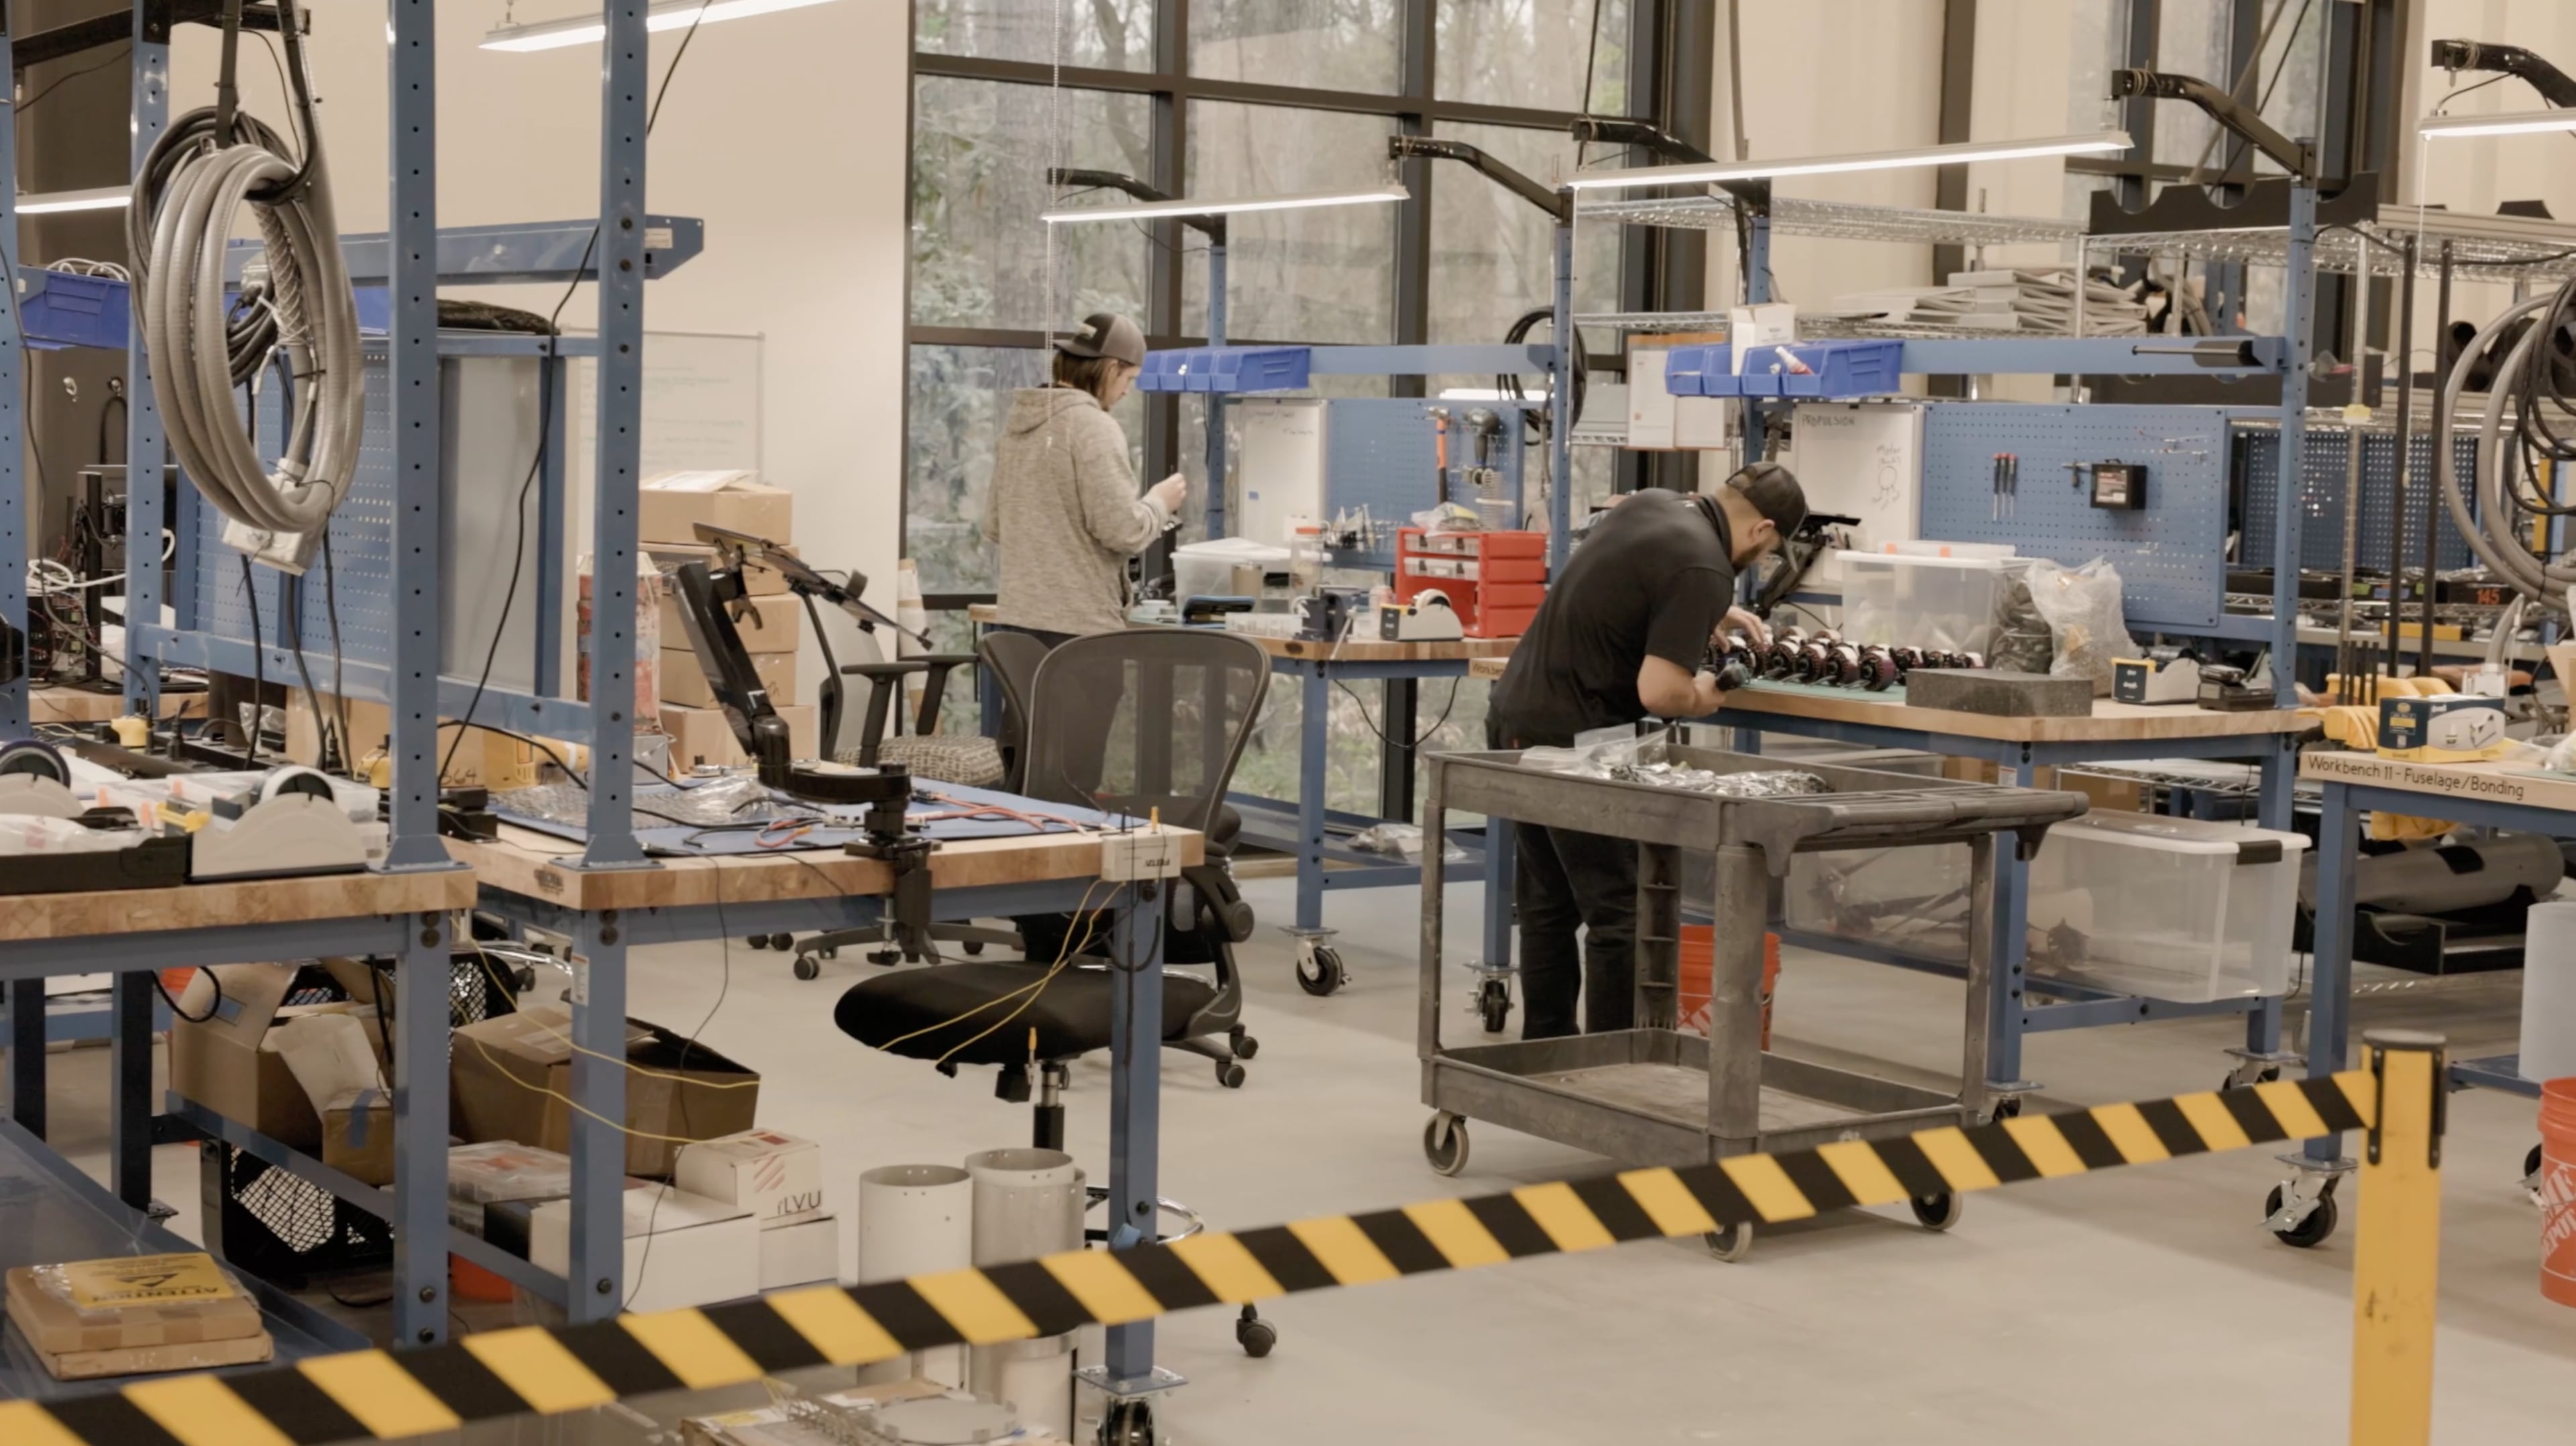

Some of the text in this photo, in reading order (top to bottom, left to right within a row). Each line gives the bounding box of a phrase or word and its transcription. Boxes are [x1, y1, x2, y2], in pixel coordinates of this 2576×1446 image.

[1802, 413, 1856, 427] PROPULSION
[2476, 588, 2500, 605] 145
[2308, 755, 2381, 777] Workbench
[2384, 766, 2393, 780] 11
[2404, 767, 2524, 801] Fuselage/Bonding
